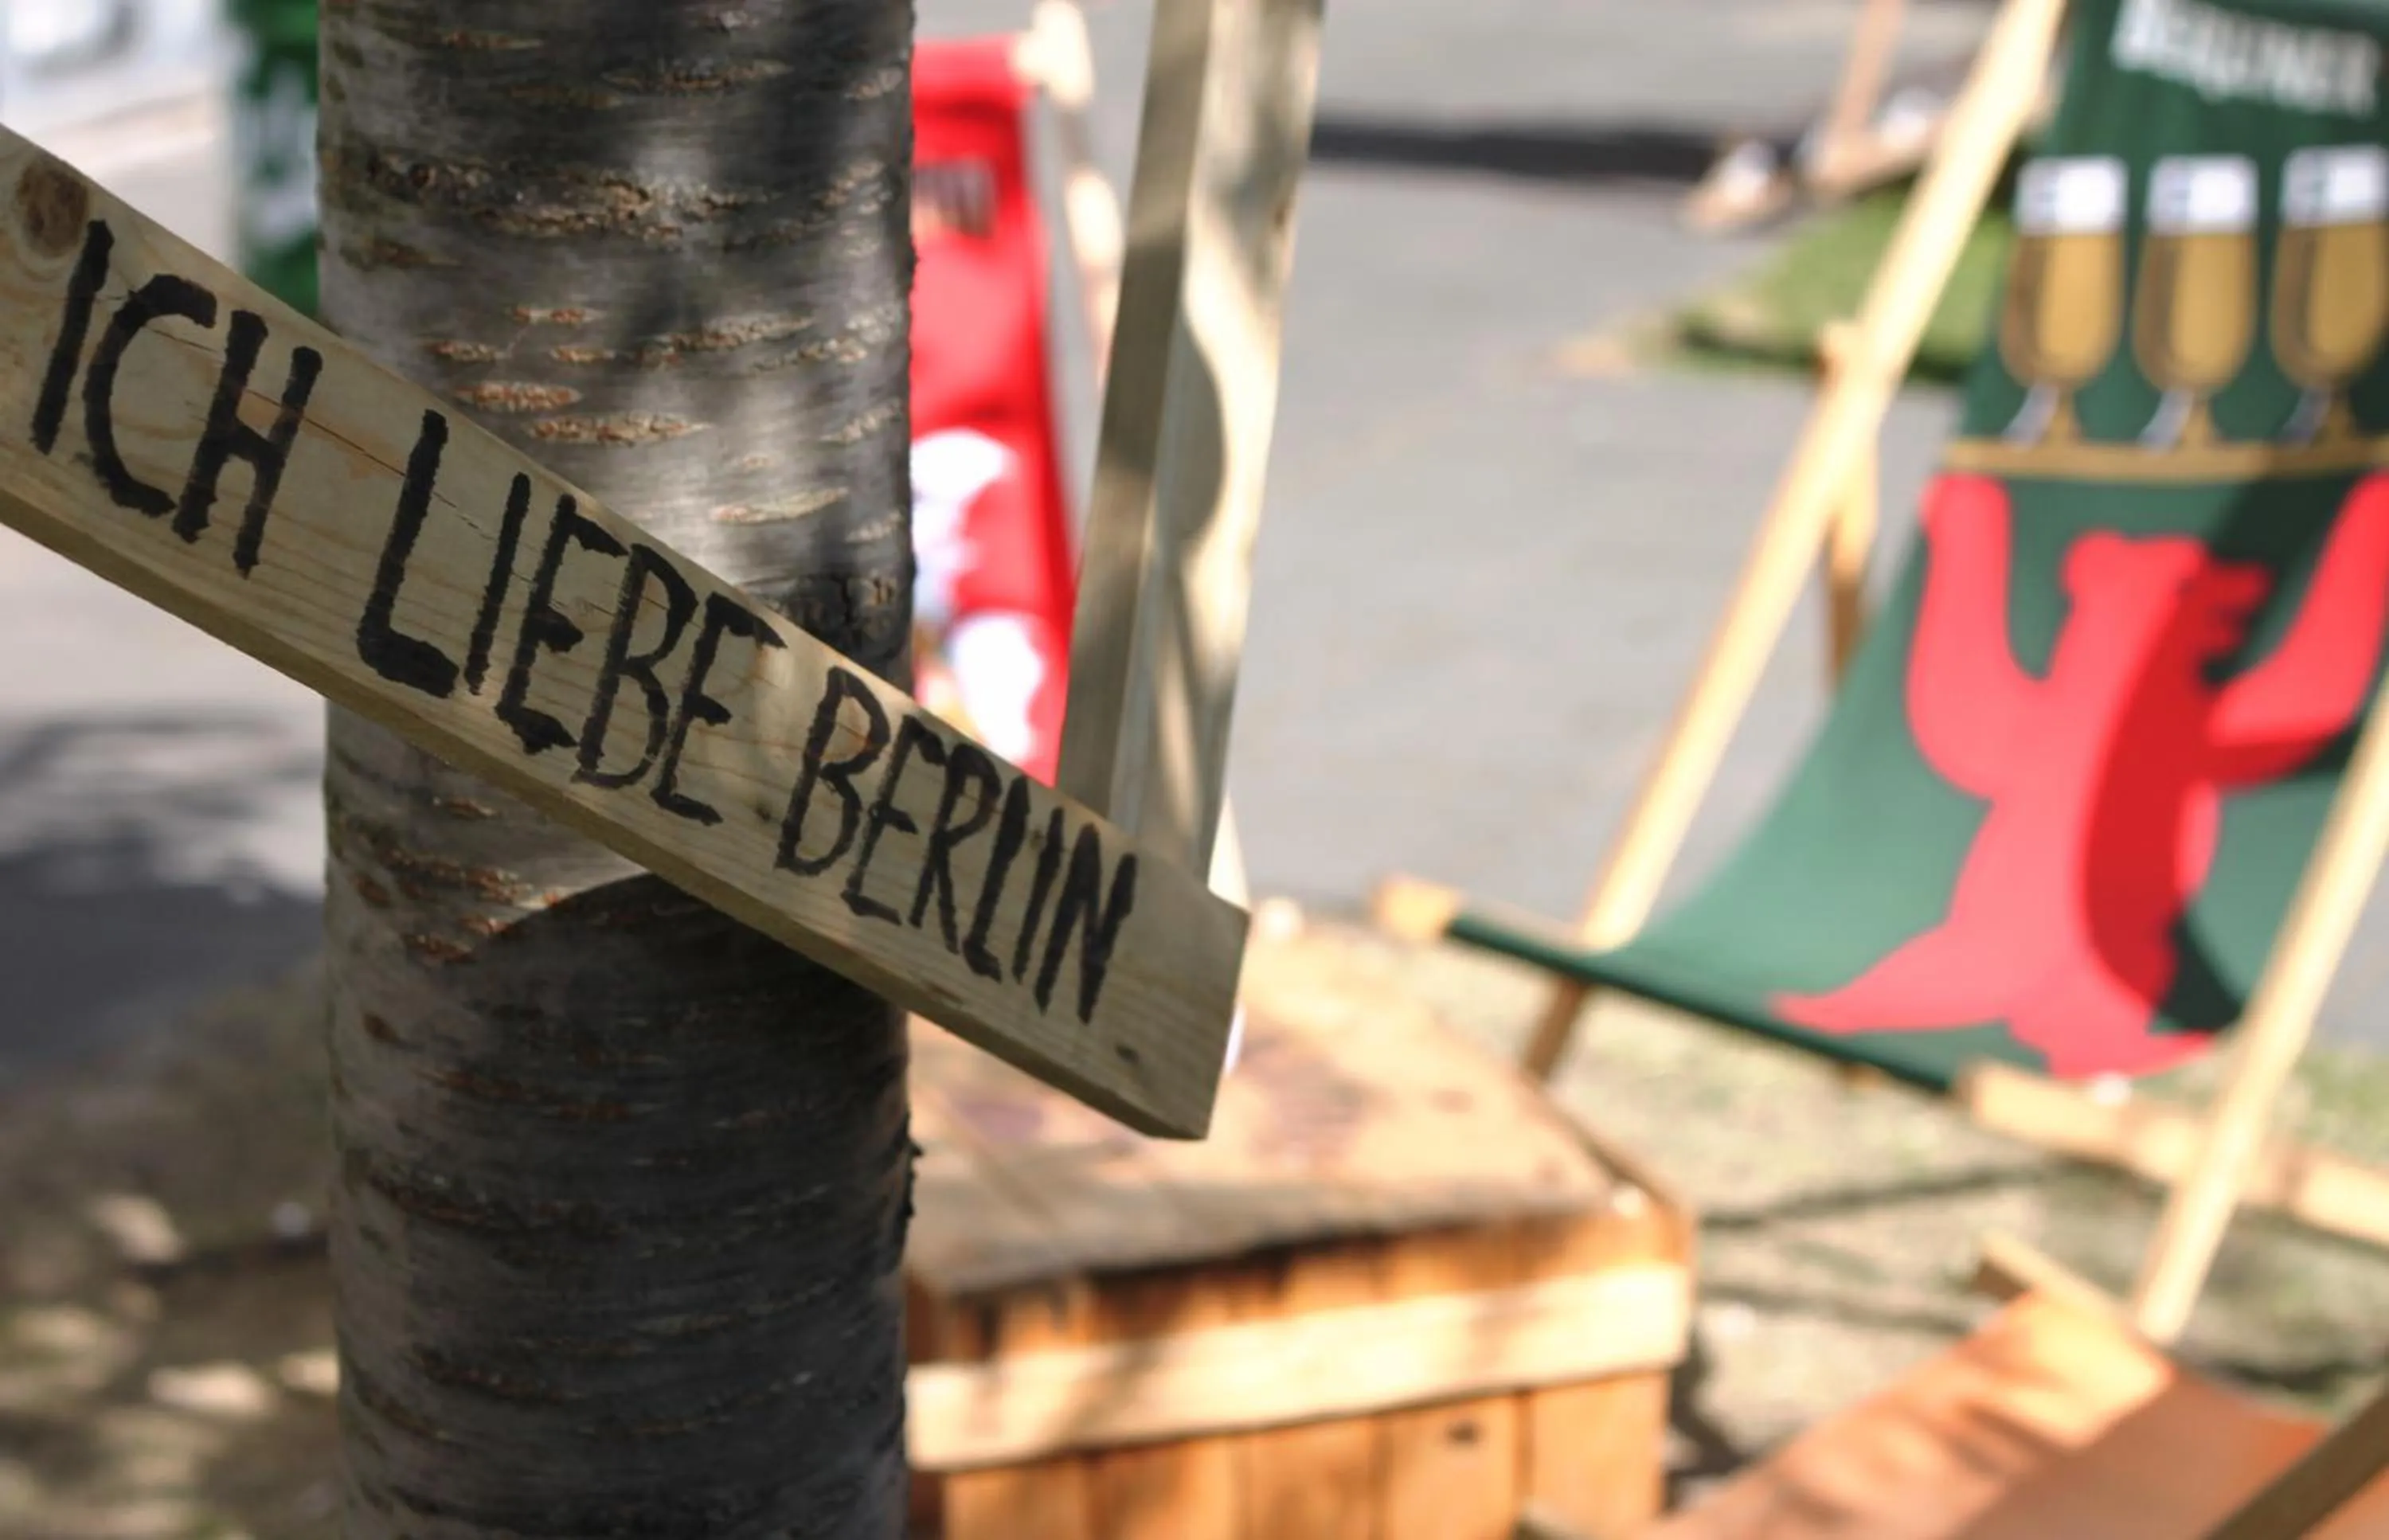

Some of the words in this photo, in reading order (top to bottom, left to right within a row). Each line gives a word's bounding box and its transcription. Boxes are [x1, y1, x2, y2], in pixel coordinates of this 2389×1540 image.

[31, 219, 323, 580] ICH
[356, 408, 788, 825] LIEBE
[774, 666, 1137, 1026] BERLIN
